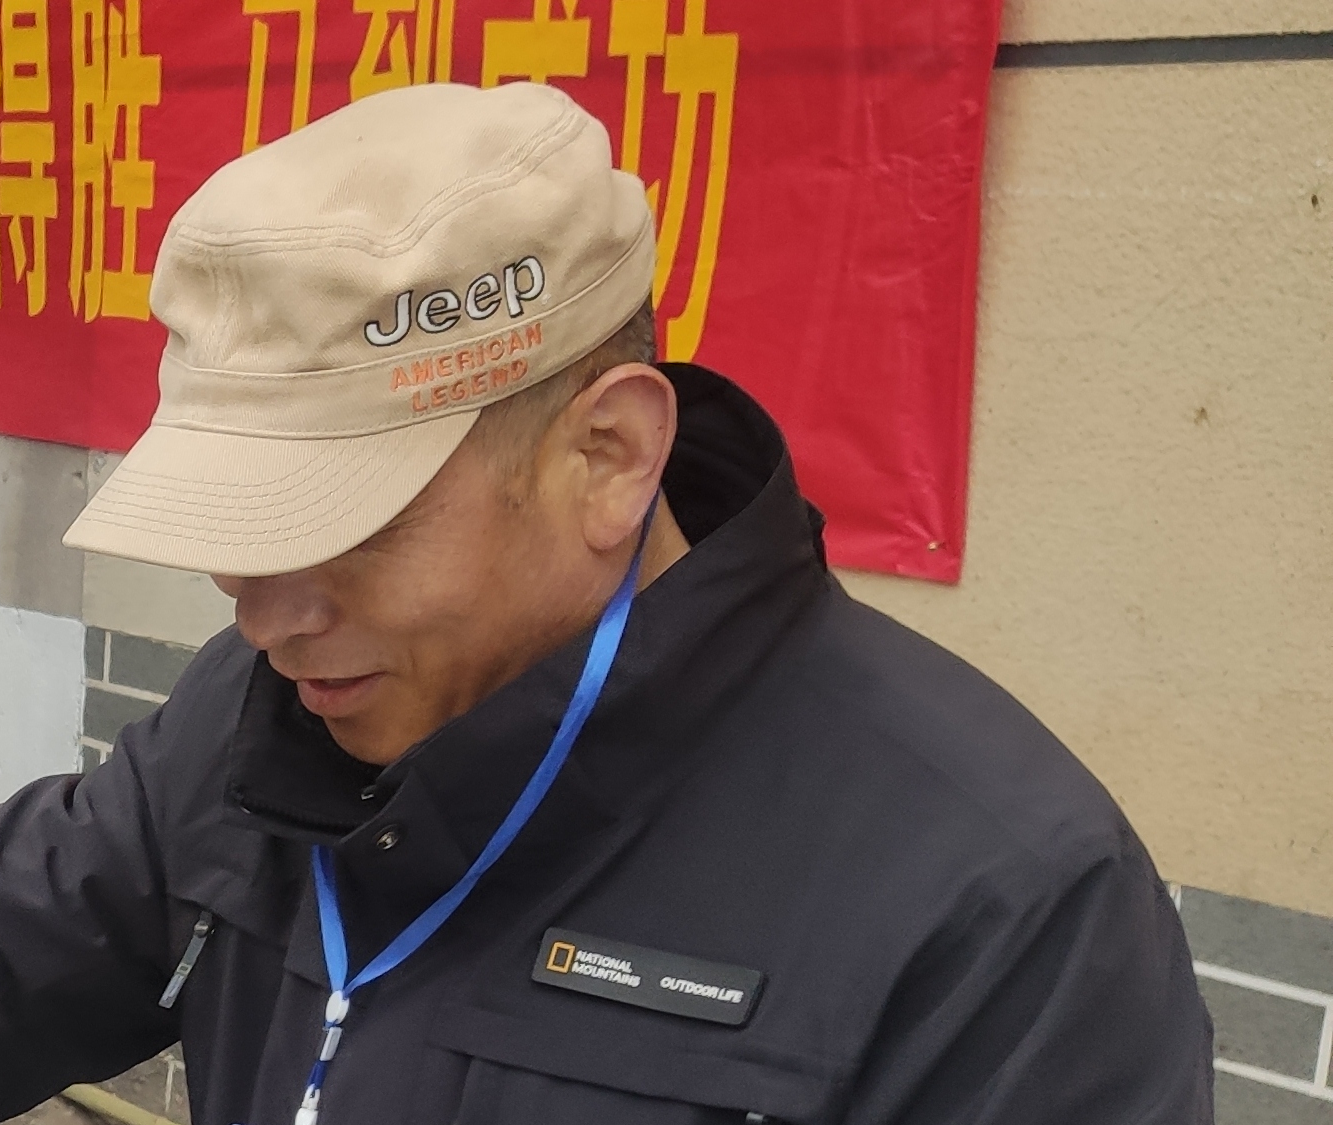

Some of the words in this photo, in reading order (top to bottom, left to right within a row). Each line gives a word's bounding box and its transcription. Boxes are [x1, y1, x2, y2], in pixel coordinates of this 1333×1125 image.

[364, 255, 545, 347] Jeep
[390, 322, 542, 392] AMERICAN
[412, 359, 529, 413] LEGEND
[572, 963, 641, 988] MOUNTAINS
[574, 950, 633, 973] NATIONAL
[660, 976, 717, 1000] OUTDOOR
[717, 987, 744, 1004] LIFE
